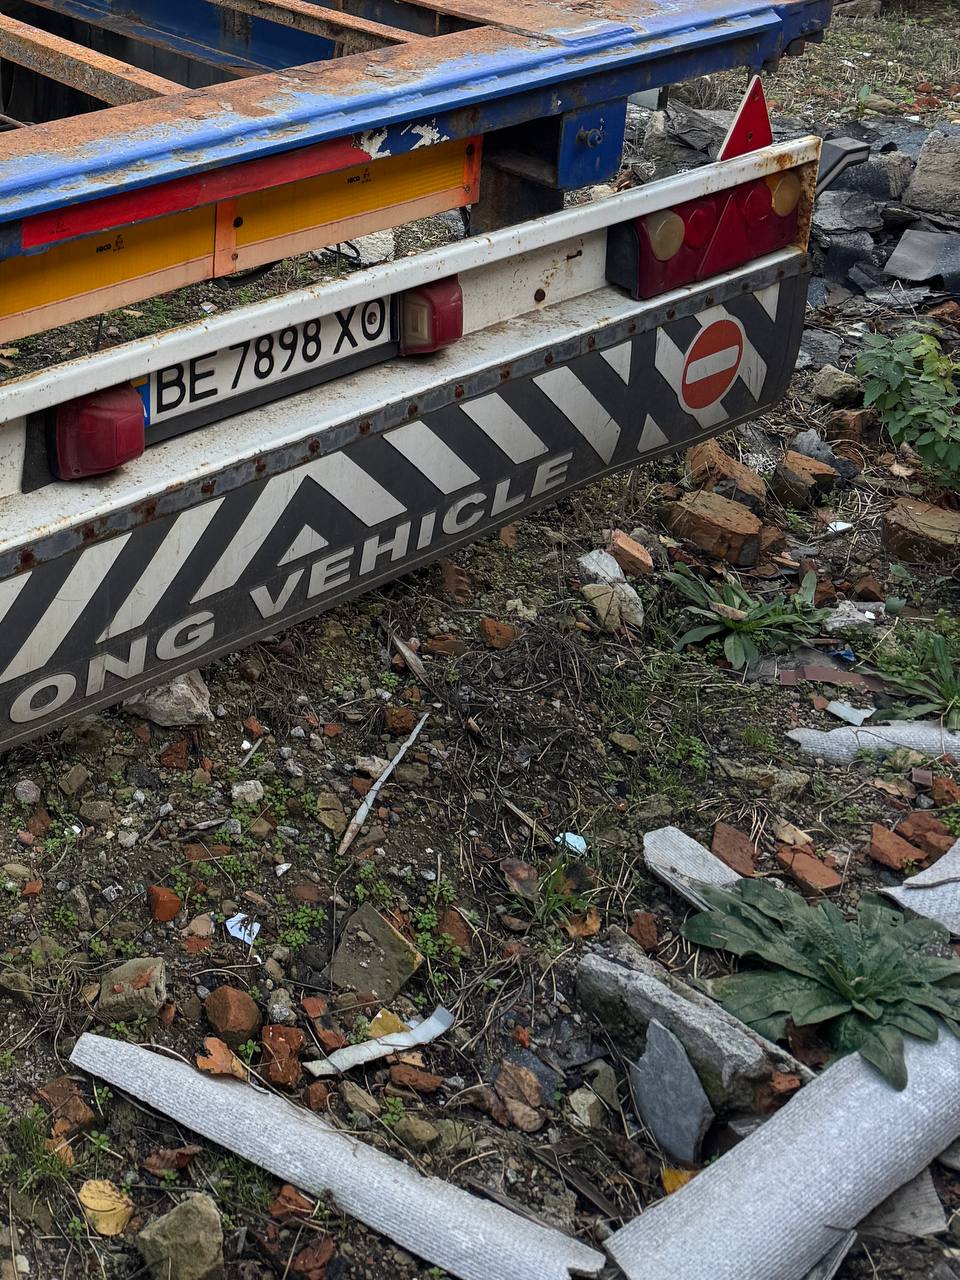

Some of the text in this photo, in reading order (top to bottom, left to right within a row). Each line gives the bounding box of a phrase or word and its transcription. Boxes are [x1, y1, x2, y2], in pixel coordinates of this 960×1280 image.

[156, 297, 386, 414] BE 7898 XO
[249, 451, 573, 619] VEHICLE
